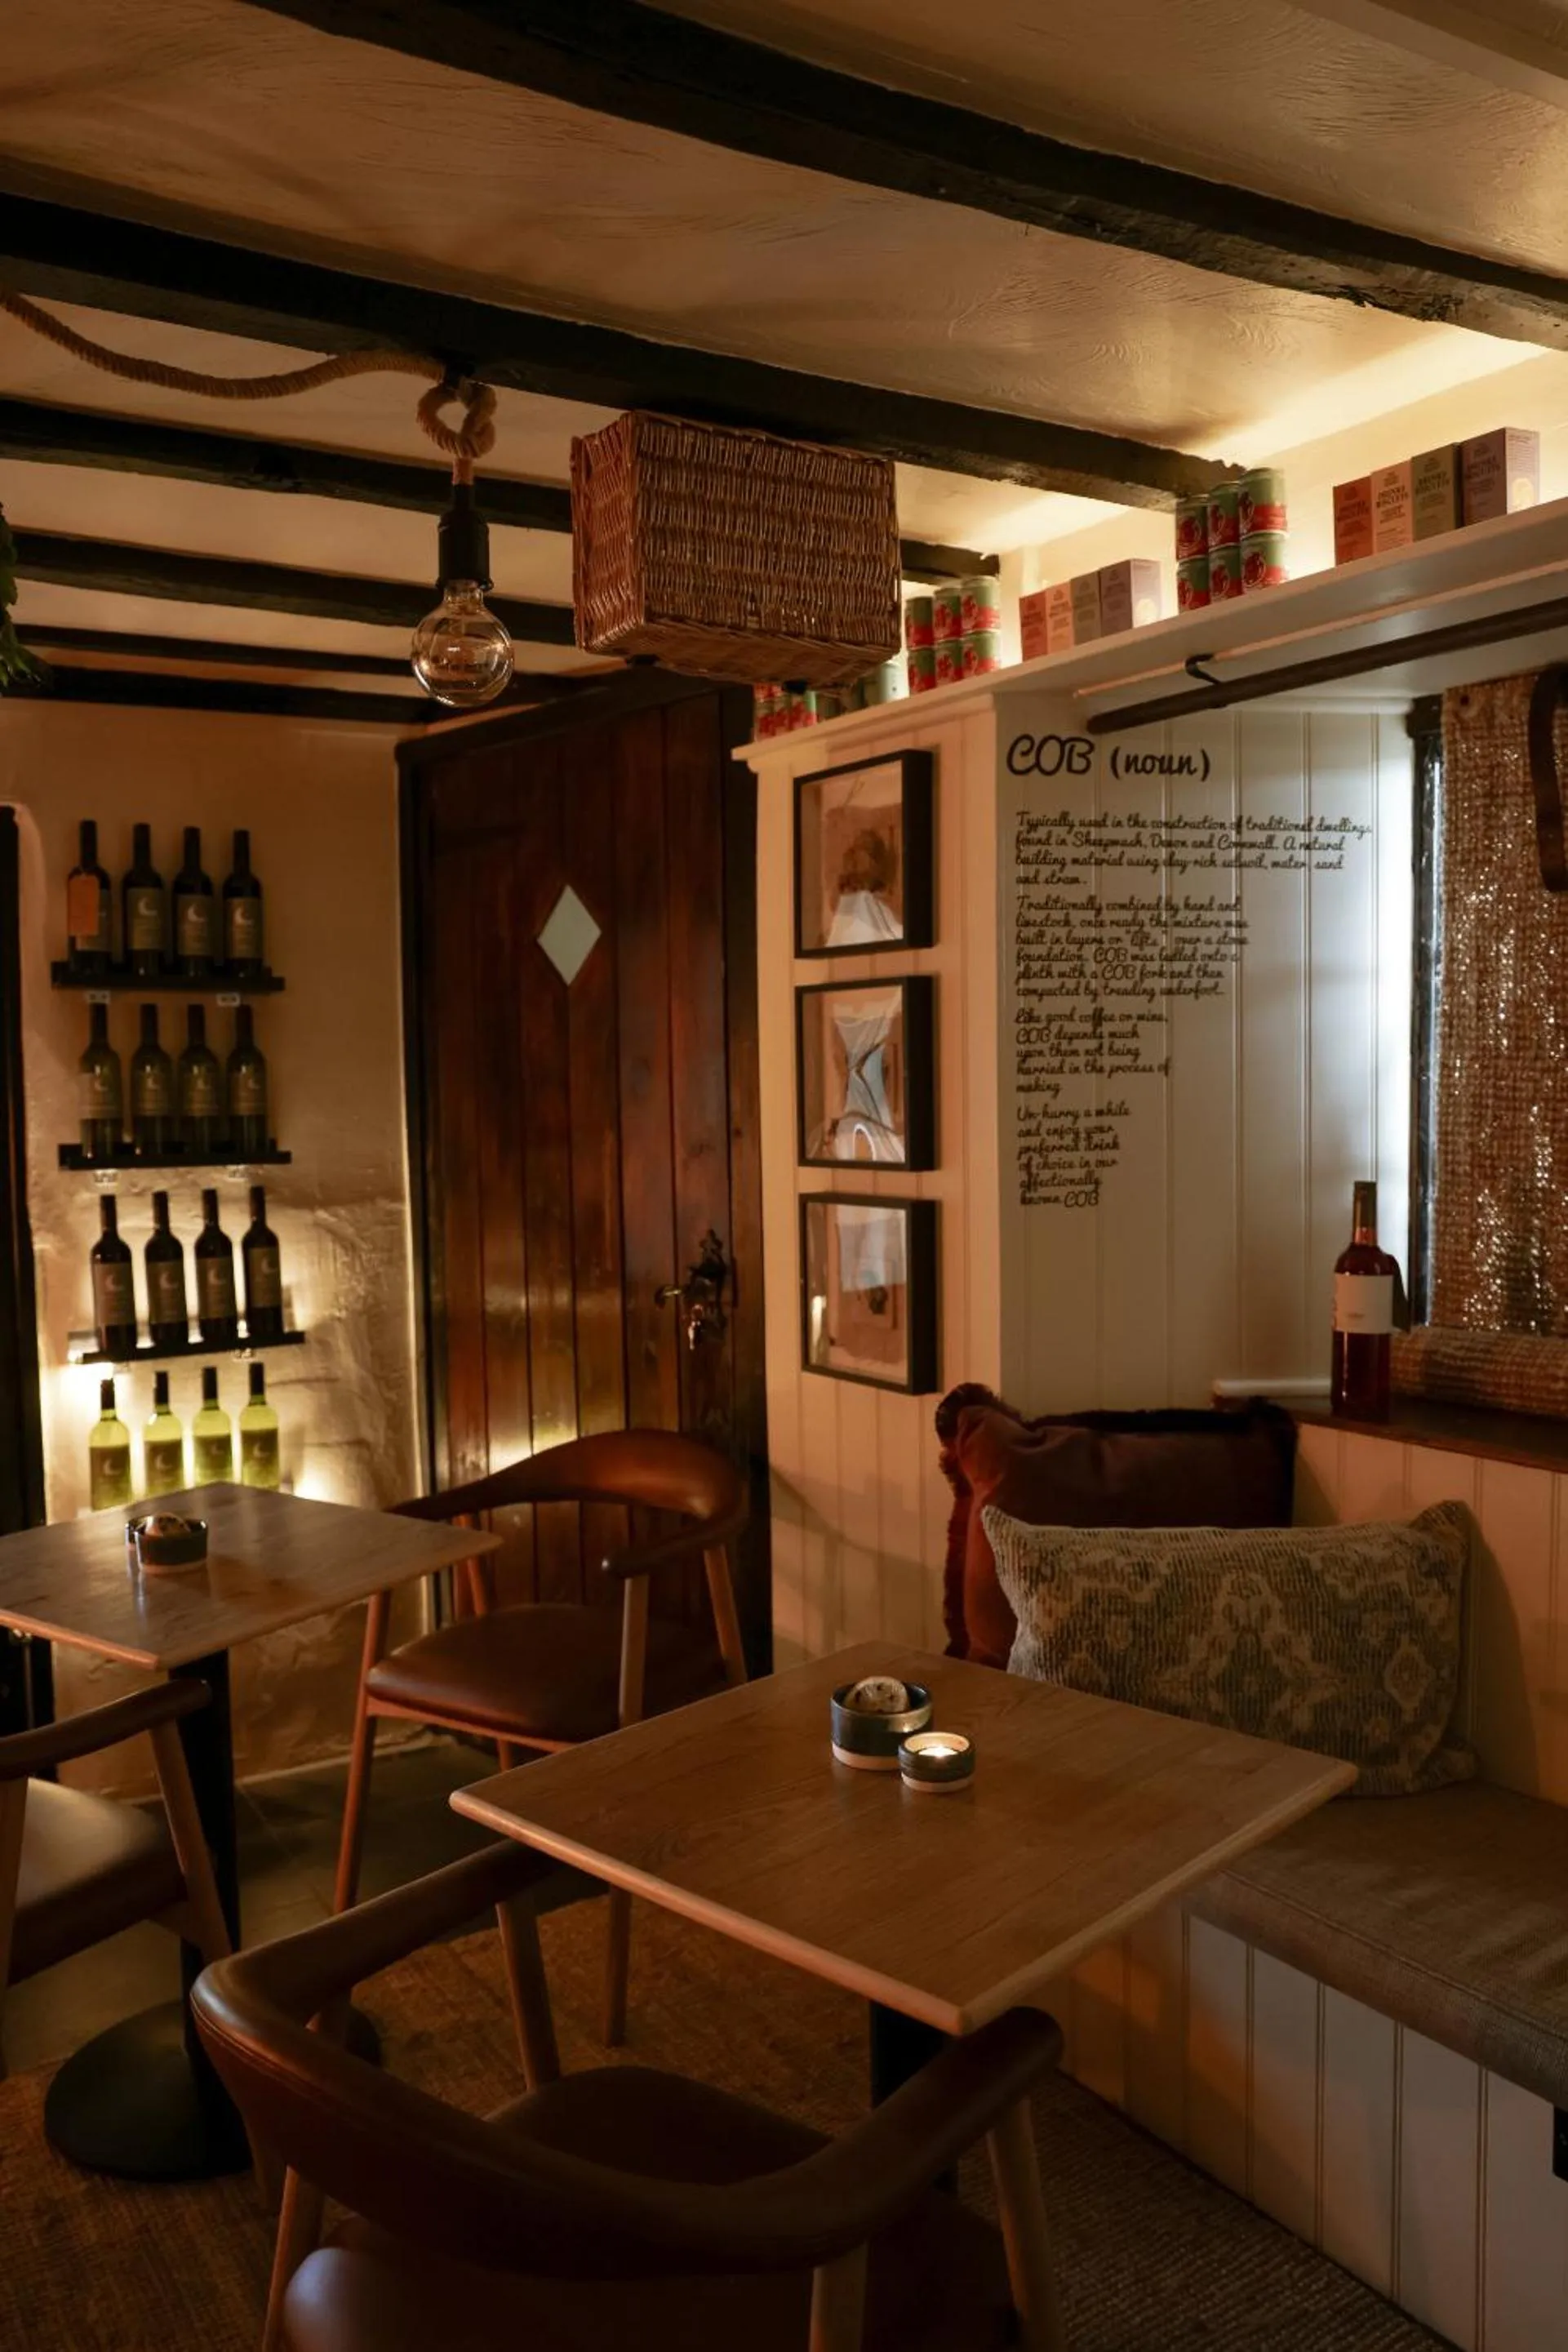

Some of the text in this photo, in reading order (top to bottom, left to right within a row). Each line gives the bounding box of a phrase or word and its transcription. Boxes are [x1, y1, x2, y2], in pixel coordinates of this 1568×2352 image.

[1006, 734, 1211, 782] COB (noun)
[1015, 811, 1076, 834] Typically
[1078, 811, 1108, 828] used
[1112, 815, 1126, 828] in
[1127, 812, 1148, 828] the
[1150, 814, 1226, 829] construction
[1228, 815, 1242, 834] of
[1246, 815, 1313, 832] traditional
[1015, 830, 1052, 852] found
[1055, 834, 1068, 847] in
[1149, 833, 1189, 848] Devon
[1191, 833, 1215, 848] and
[1283, 835, 1297, 850] A
[1299, 835, 1345, 851] natural
[1015, 849, 1067, 874] building
[1071, 851, 1125, 866] material
[1126, 855, 1159, 875] using
[1313, 854, 1345, 870] sand
[1015, 868, 1087, 885] and straw.
[1016, 895, 1241, 918] Traditionally combined by hand and
[1079, 918, 1106, 927] once
[1109, 912, 1144, 934] ready
[1149, 913, 1168, 928] the
[1173, 914, 1221, 928] mixture
[1224, 919, 1250, 928] was
[1015, 929, 1047, 945] built
[1051, 931, 1064, 945] in
[1066, 929, 1105, 951] layers
[1108, 936, 1123, 945] or
[1175, 936, 1202, 945] over
[1216, 931, 1249, 945] stone
[1094, 946, 1128, 963] COB
[1130, 954, 1156, 962] was
[1200, 948, 1228, 962] onto
[1015, 963, 1225, 985] plinth with a COB fork and then
[1015, 980, 1082, 1003] compacted
[1084, 980, 1099, 1003] by
[1104, 981, 1157, 1004] treading
[1014, 1007, 1042, 1024] Like
[1045, 1006, 1076, 1028] good
[1079, 1007, 1116, 1029] coffee
[1118, 1013, 1133, 1022] or
[1015, 1023, 1140, 1046] COB depends much
[1015, 1049, 1046, 1064] upon
[1083, 1041, 1104, 1056] not
[1107, 1041, 1141, 1063] being
[1016, 1056, 1170, 1079] hurried in the process of
[1015, 1076, 1062, 1100] making
[1083, 1108, 1092, 1118] a
[1094, 1099, 1132, 1118] while
[1016, 1120, 1115, 1145] and enjoy your
[1016, 1135, 1120, 1161] preferred drink
[1018, 1154, 1120, 1176] of choice in our
[1020, 1189, 1099, 1208] known COB
